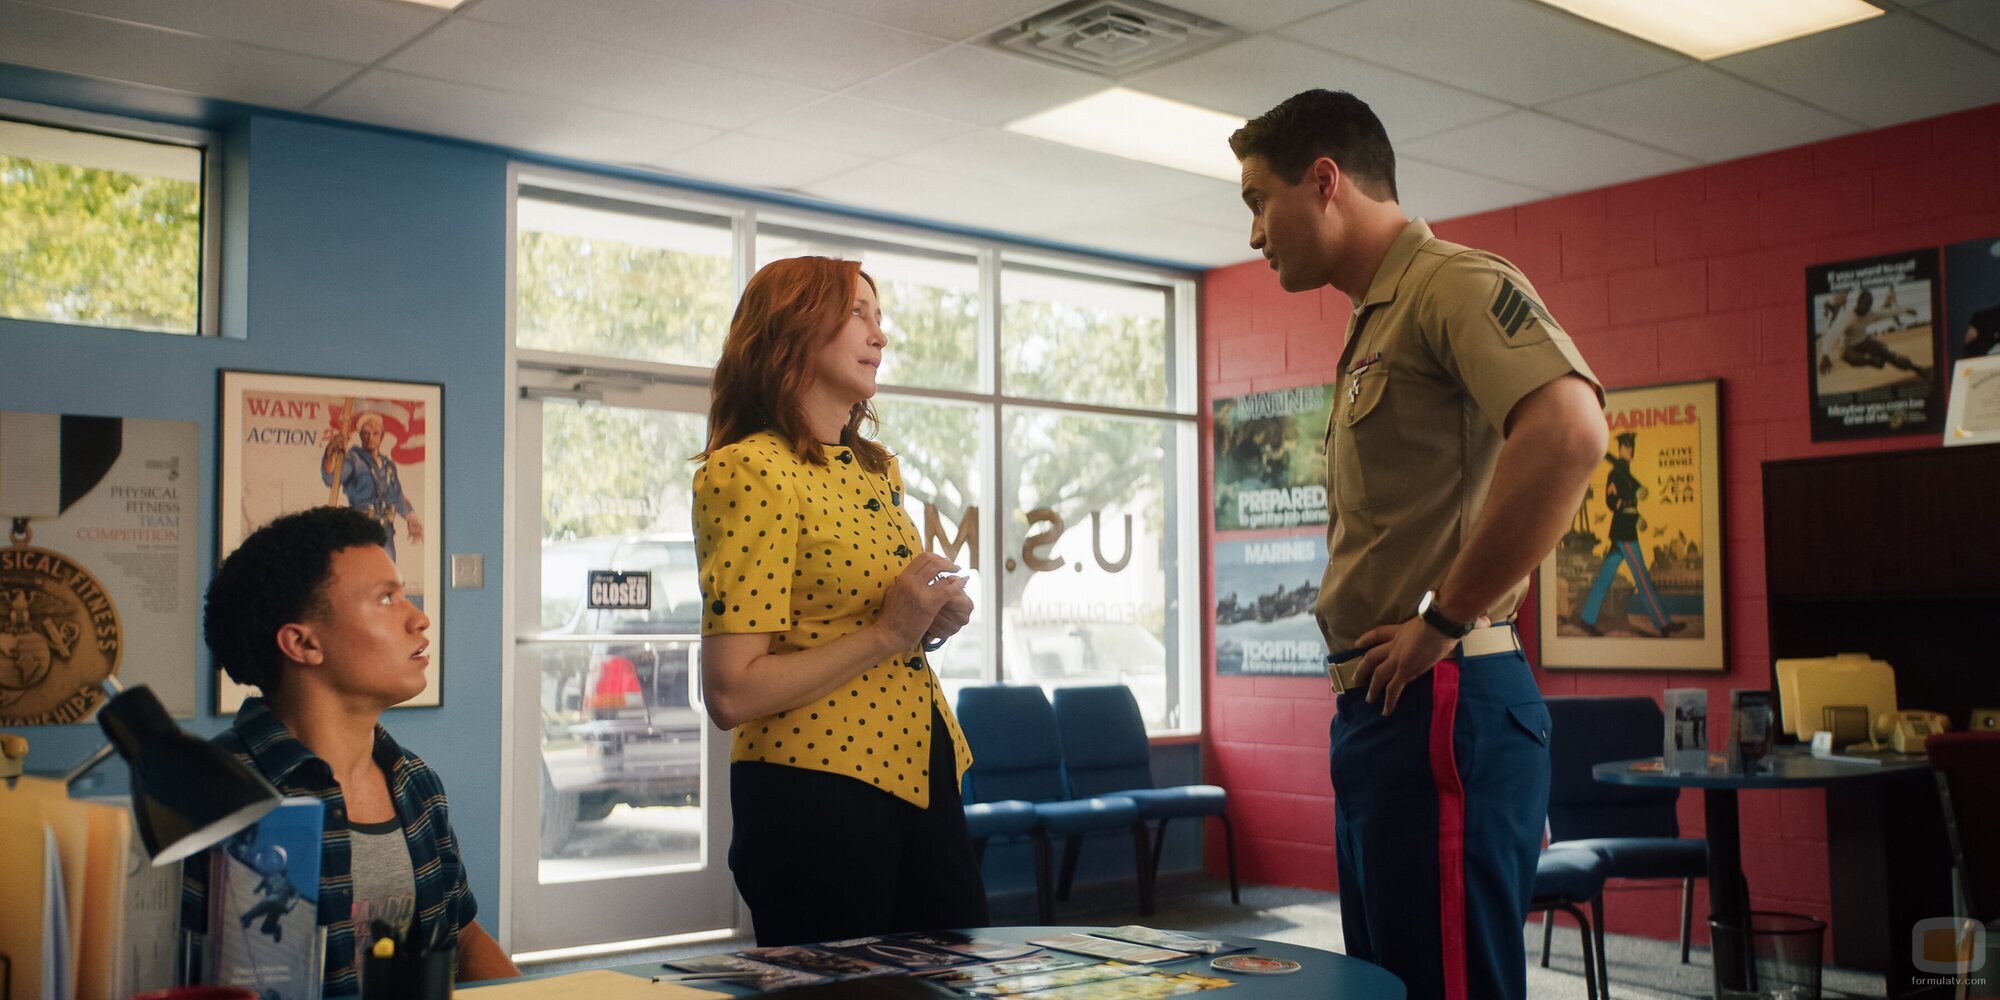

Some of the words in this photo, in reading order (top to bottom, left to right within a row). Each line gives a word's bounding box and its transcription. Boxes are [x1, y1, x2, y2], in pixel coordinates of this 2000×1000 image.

[247, 397, 320, 420] WANT
[1237, 386, 1324, 419] MARINES
[1827, 404, 1865, 417] Maybe
[1867, 402, 1885, 415] you
[1886, 400, 1908, 411] can
[1909, 398, 1925, 409] be
[247, 427, 318, 446] ACTION
[1659, 447, 1692, 457] ACTIVE
[1659, 457, 1692, 467] SERVICE
[1658, 474, 1694, 485] LAND
[111, 486, 178, 499] PHYSICAL
[1660, 483, 1694, 495] SEA
[1660, 495, 1694, 504] AIR
[126, 501, 180, 513] FITNESS
[140, 514, 180, 527] TEAM
[1284, 510, 1300, 528] job
[76, 528, 180, 542] COMPETITION
[1245, 541, 1315, 564] MARINES
[592, 582, 647, 605] CLOSED
[2, 553, 63, 578] SICAL
[68, 572, 117, 654] FITNESS
